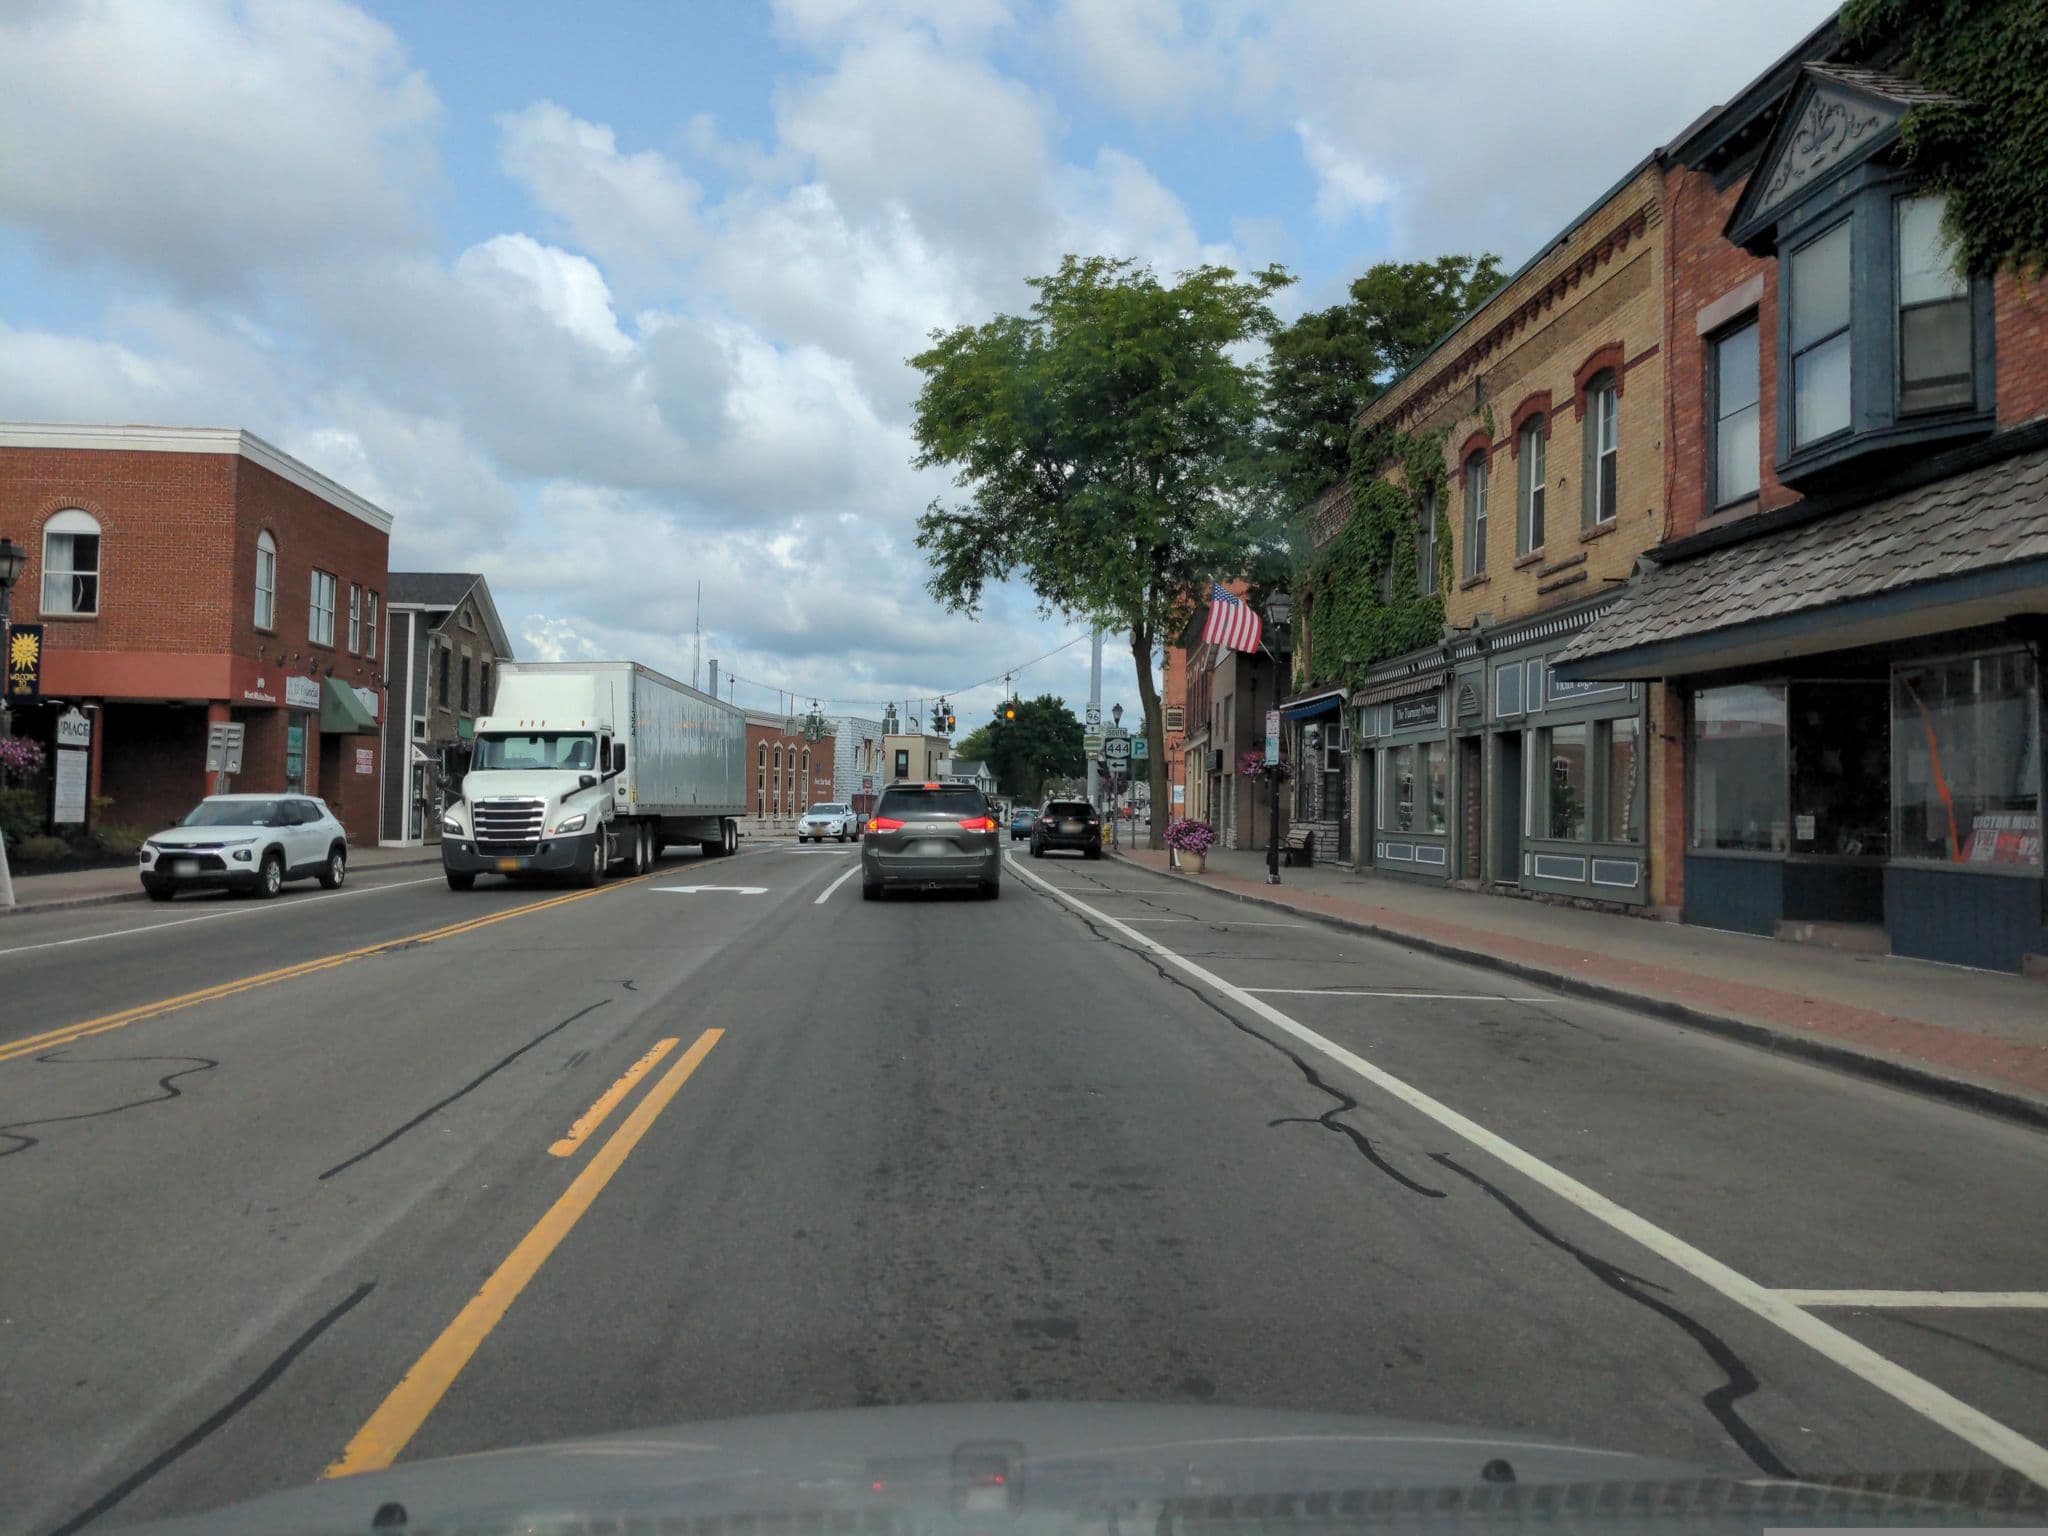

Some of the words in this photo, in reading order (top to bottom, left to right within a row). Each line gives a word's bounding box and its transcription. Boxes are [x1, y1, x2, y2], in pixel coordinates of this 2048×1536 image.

[1106, 729, 1128, 737] SOUTH
[1108, 744, 1129, 753] 444
[1135, 742, 1145, 755] P
[1972, 816, 2010, 829] VICTOR
